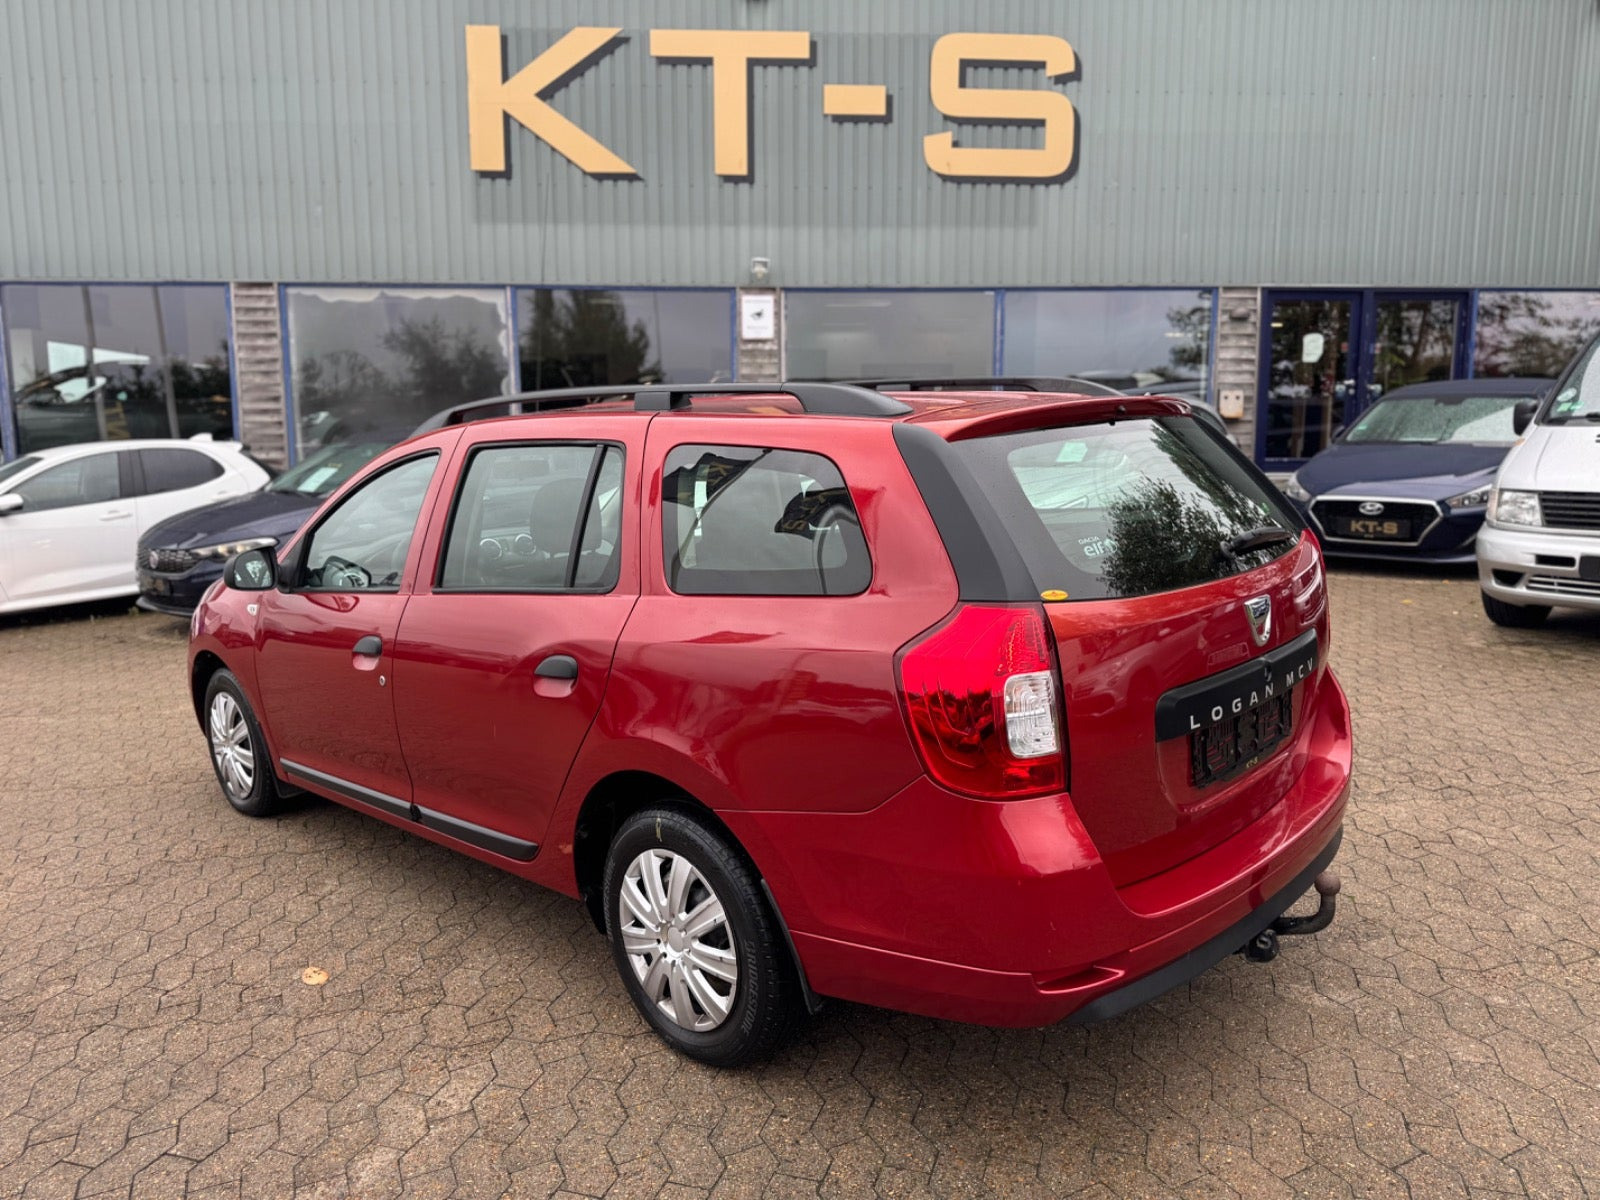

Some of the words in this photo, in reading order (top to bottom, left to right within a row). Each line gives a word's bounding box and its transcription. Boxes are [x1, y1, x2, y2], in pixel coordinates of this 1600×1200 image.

[465, 24, 1076, 178] KT-S
[1084, 541, 1105, 557] elf
[1350, 519, 1398, 535] KT-S
[1190, 682, 1274, 729] LOGAN
[1286, 657, 1313, 687] MCV
